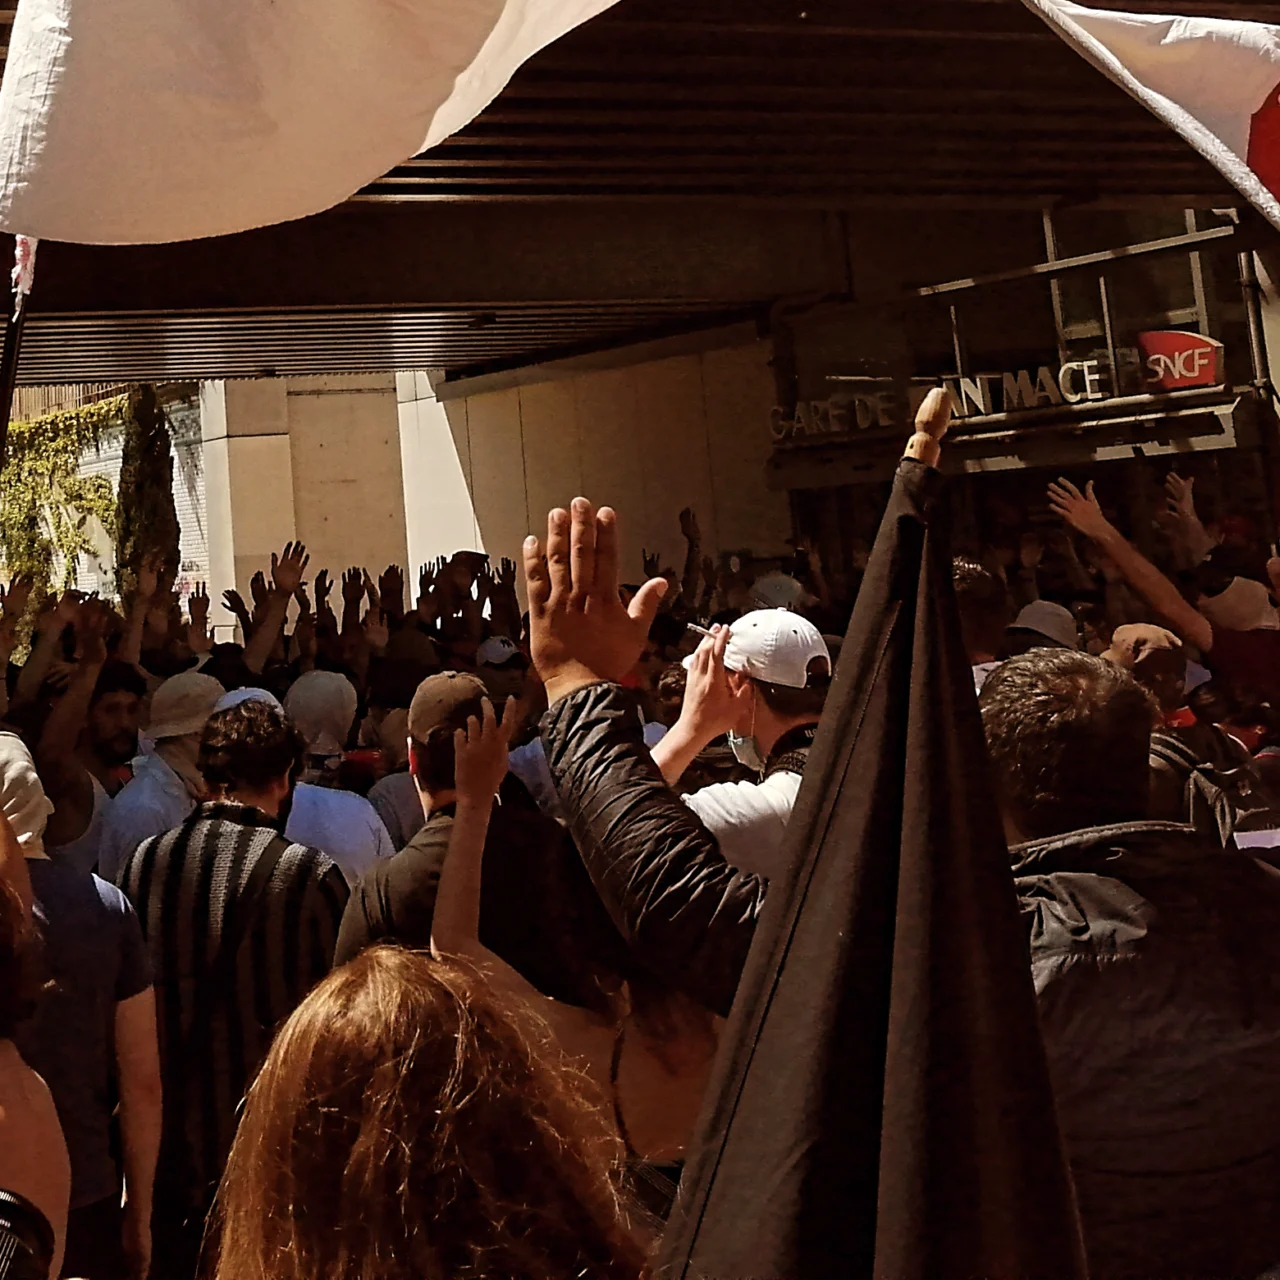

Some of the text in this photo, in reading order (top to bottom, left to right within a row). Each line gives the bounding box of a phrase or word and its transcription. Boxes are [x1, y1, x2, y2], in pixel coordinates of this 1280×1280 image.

[1146, 346, 1213, 385] SNCF
[770, 395, 849, 438] GARE
[853, 391, 897, 429] DE
